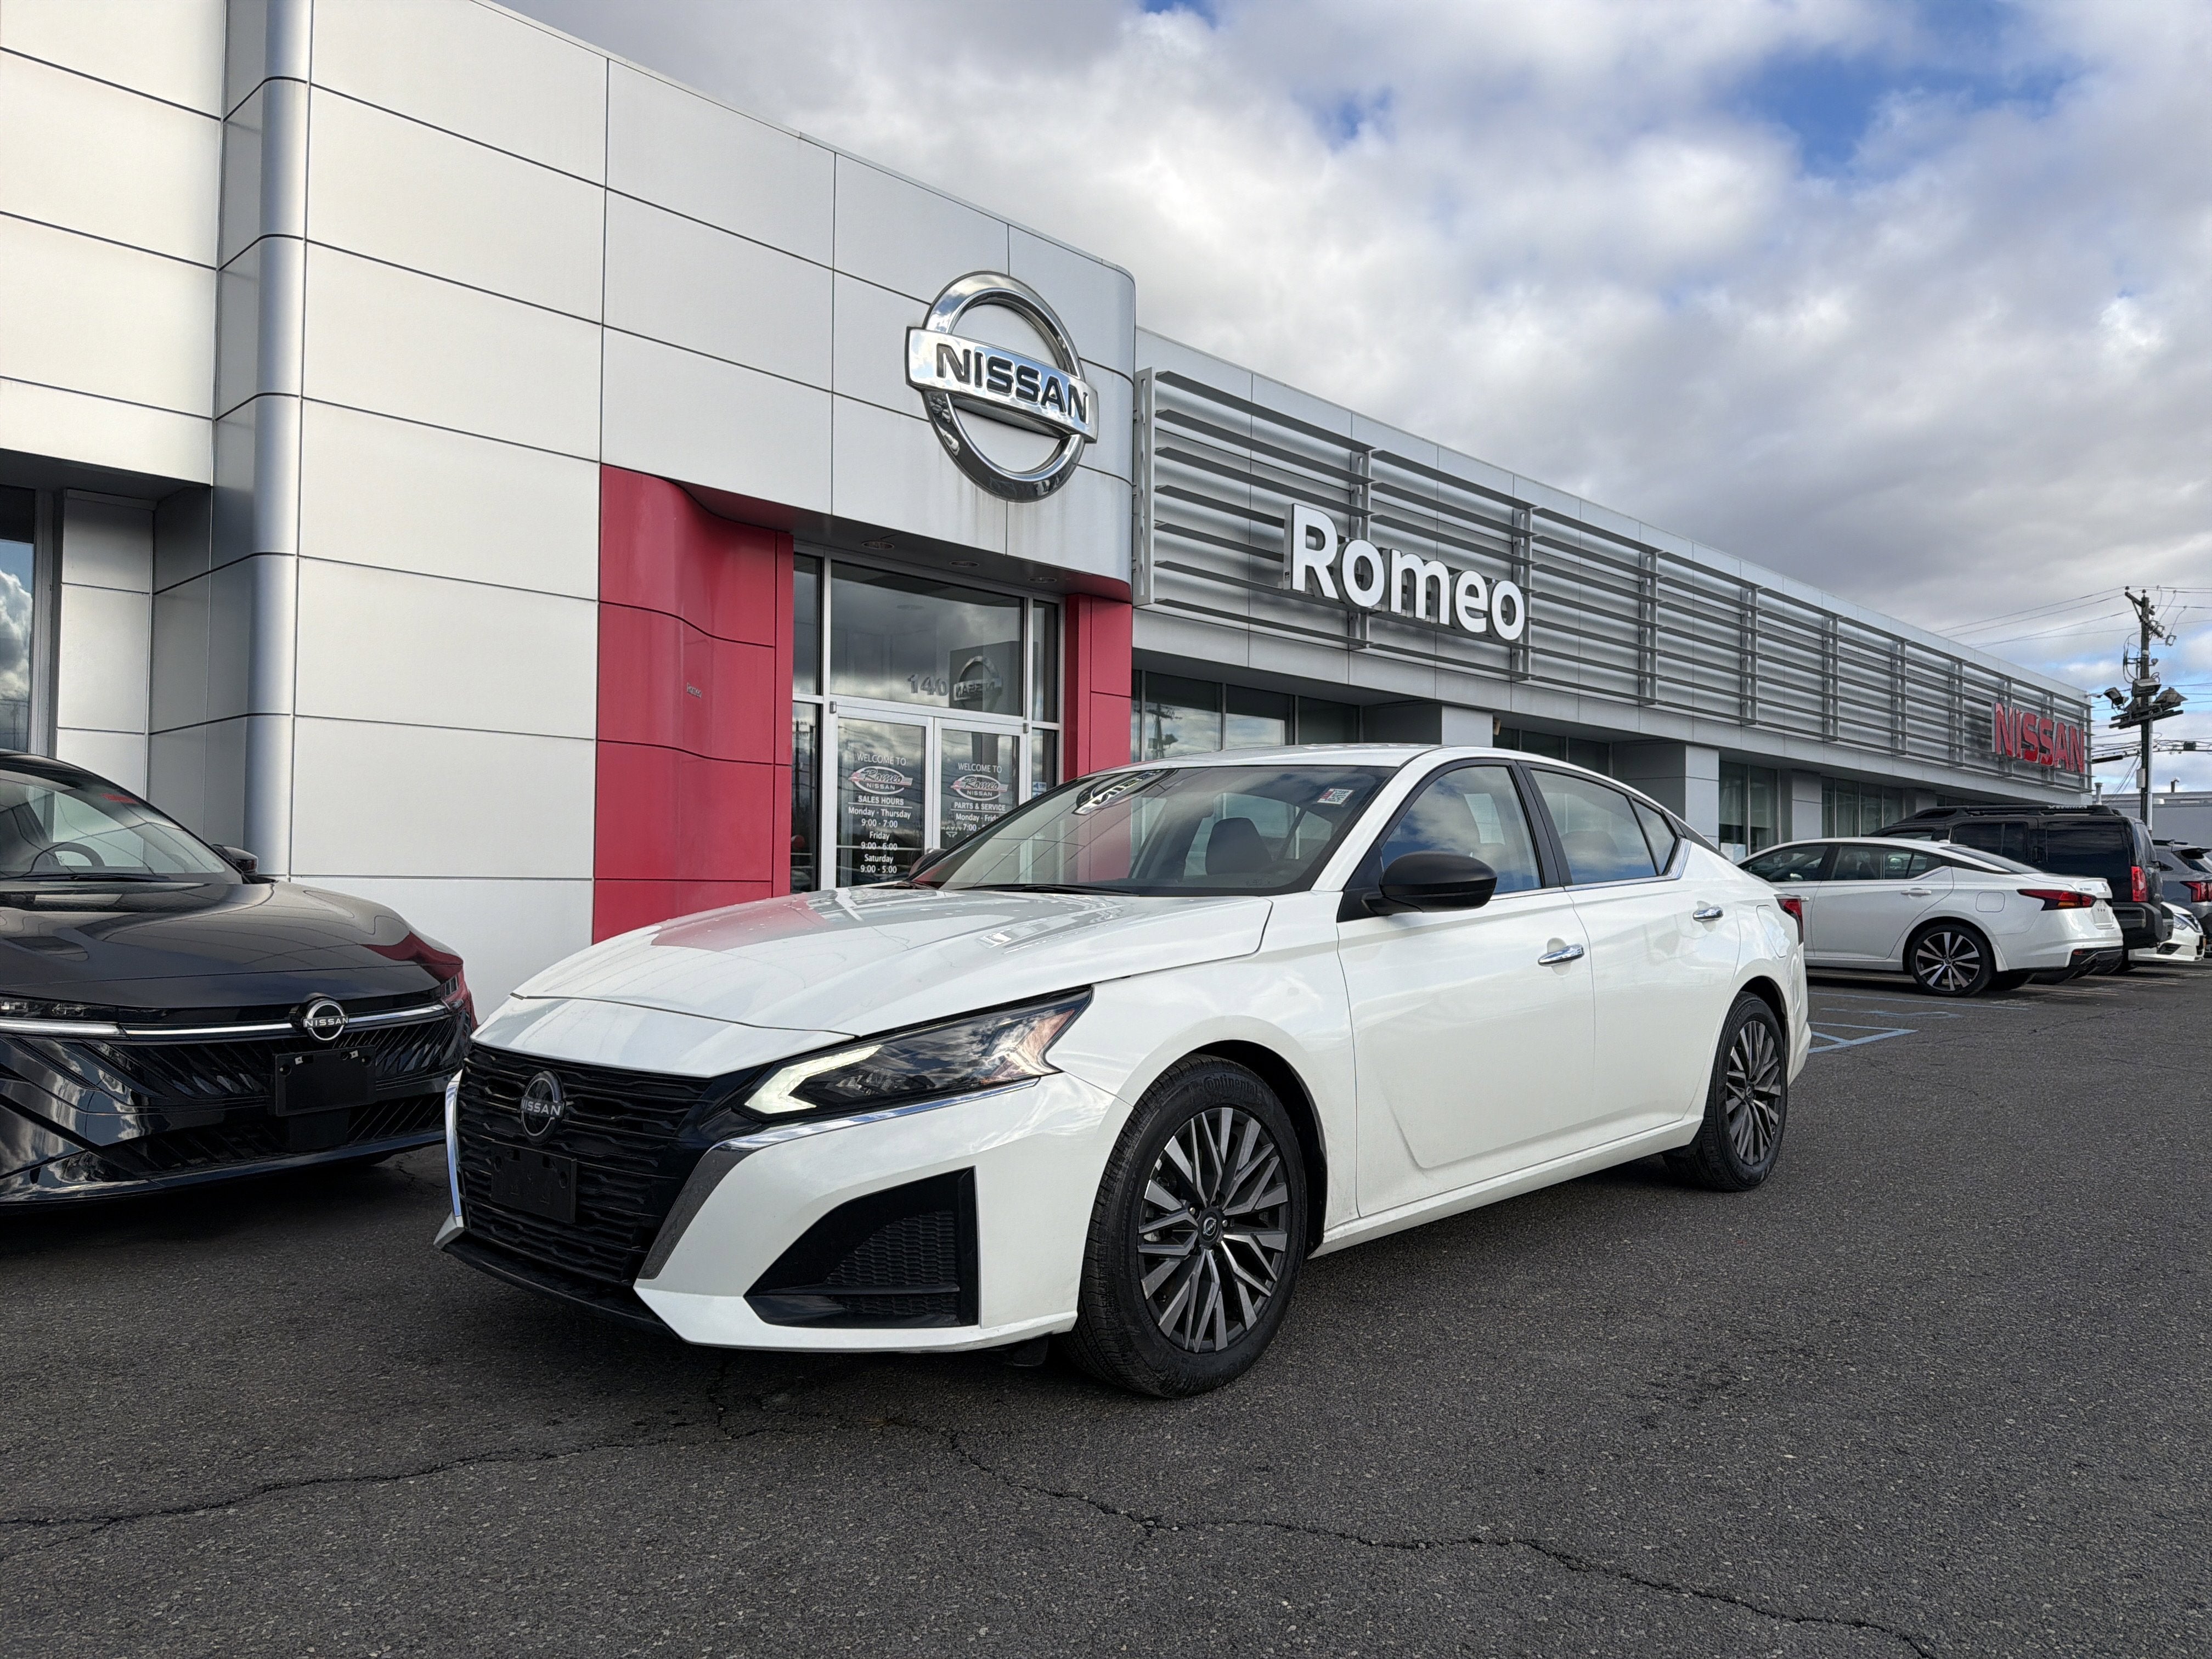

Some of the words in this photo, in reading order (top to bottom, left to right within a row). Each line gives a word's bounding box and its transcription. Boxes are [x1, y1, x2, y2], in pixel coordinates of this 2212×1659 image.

[936, 343, 1089, 425] NISSAN
[1290, 503, 1525, 641] Romeo
[907, 674, 948, 696] 140
[1994, 702, 2085, 774] NISSAN
[857, 753, 894, 765] WELCOME
[896, 757, 906, 766] TO
[958, 763, 991, 772] WELCOME
[992, 765, 1002, 774] TO
[860, 768, 902, 783] Romeo
[962, 776, 999, 790] Romeo
[858, 795, 879, 804] SALES
[881, 797, 904, 805] HOURS
[954, 802, 974, 810] PARTS
[848, 806, 875, 817] Monday
[881, 809, 911, 820] Thursday
[956, 813, 979, 823] Monday
[861, 818, 877, 827] 9:00
[883, 820, 898, 828] 7:00
[869, 831, 890, 841] Friday
[861, 842, 877, 850] 9:00
[864, 854, 894, 864] Saturday
[860, 865, 876, 873] 9:00
[882, 865, 898, 873] 5:00
[304, 1017, 348, 1028] NISSAN
[1203, 1074, 1257, 1096] Continental
[521, 1099, 561, 1116] NISSAN
